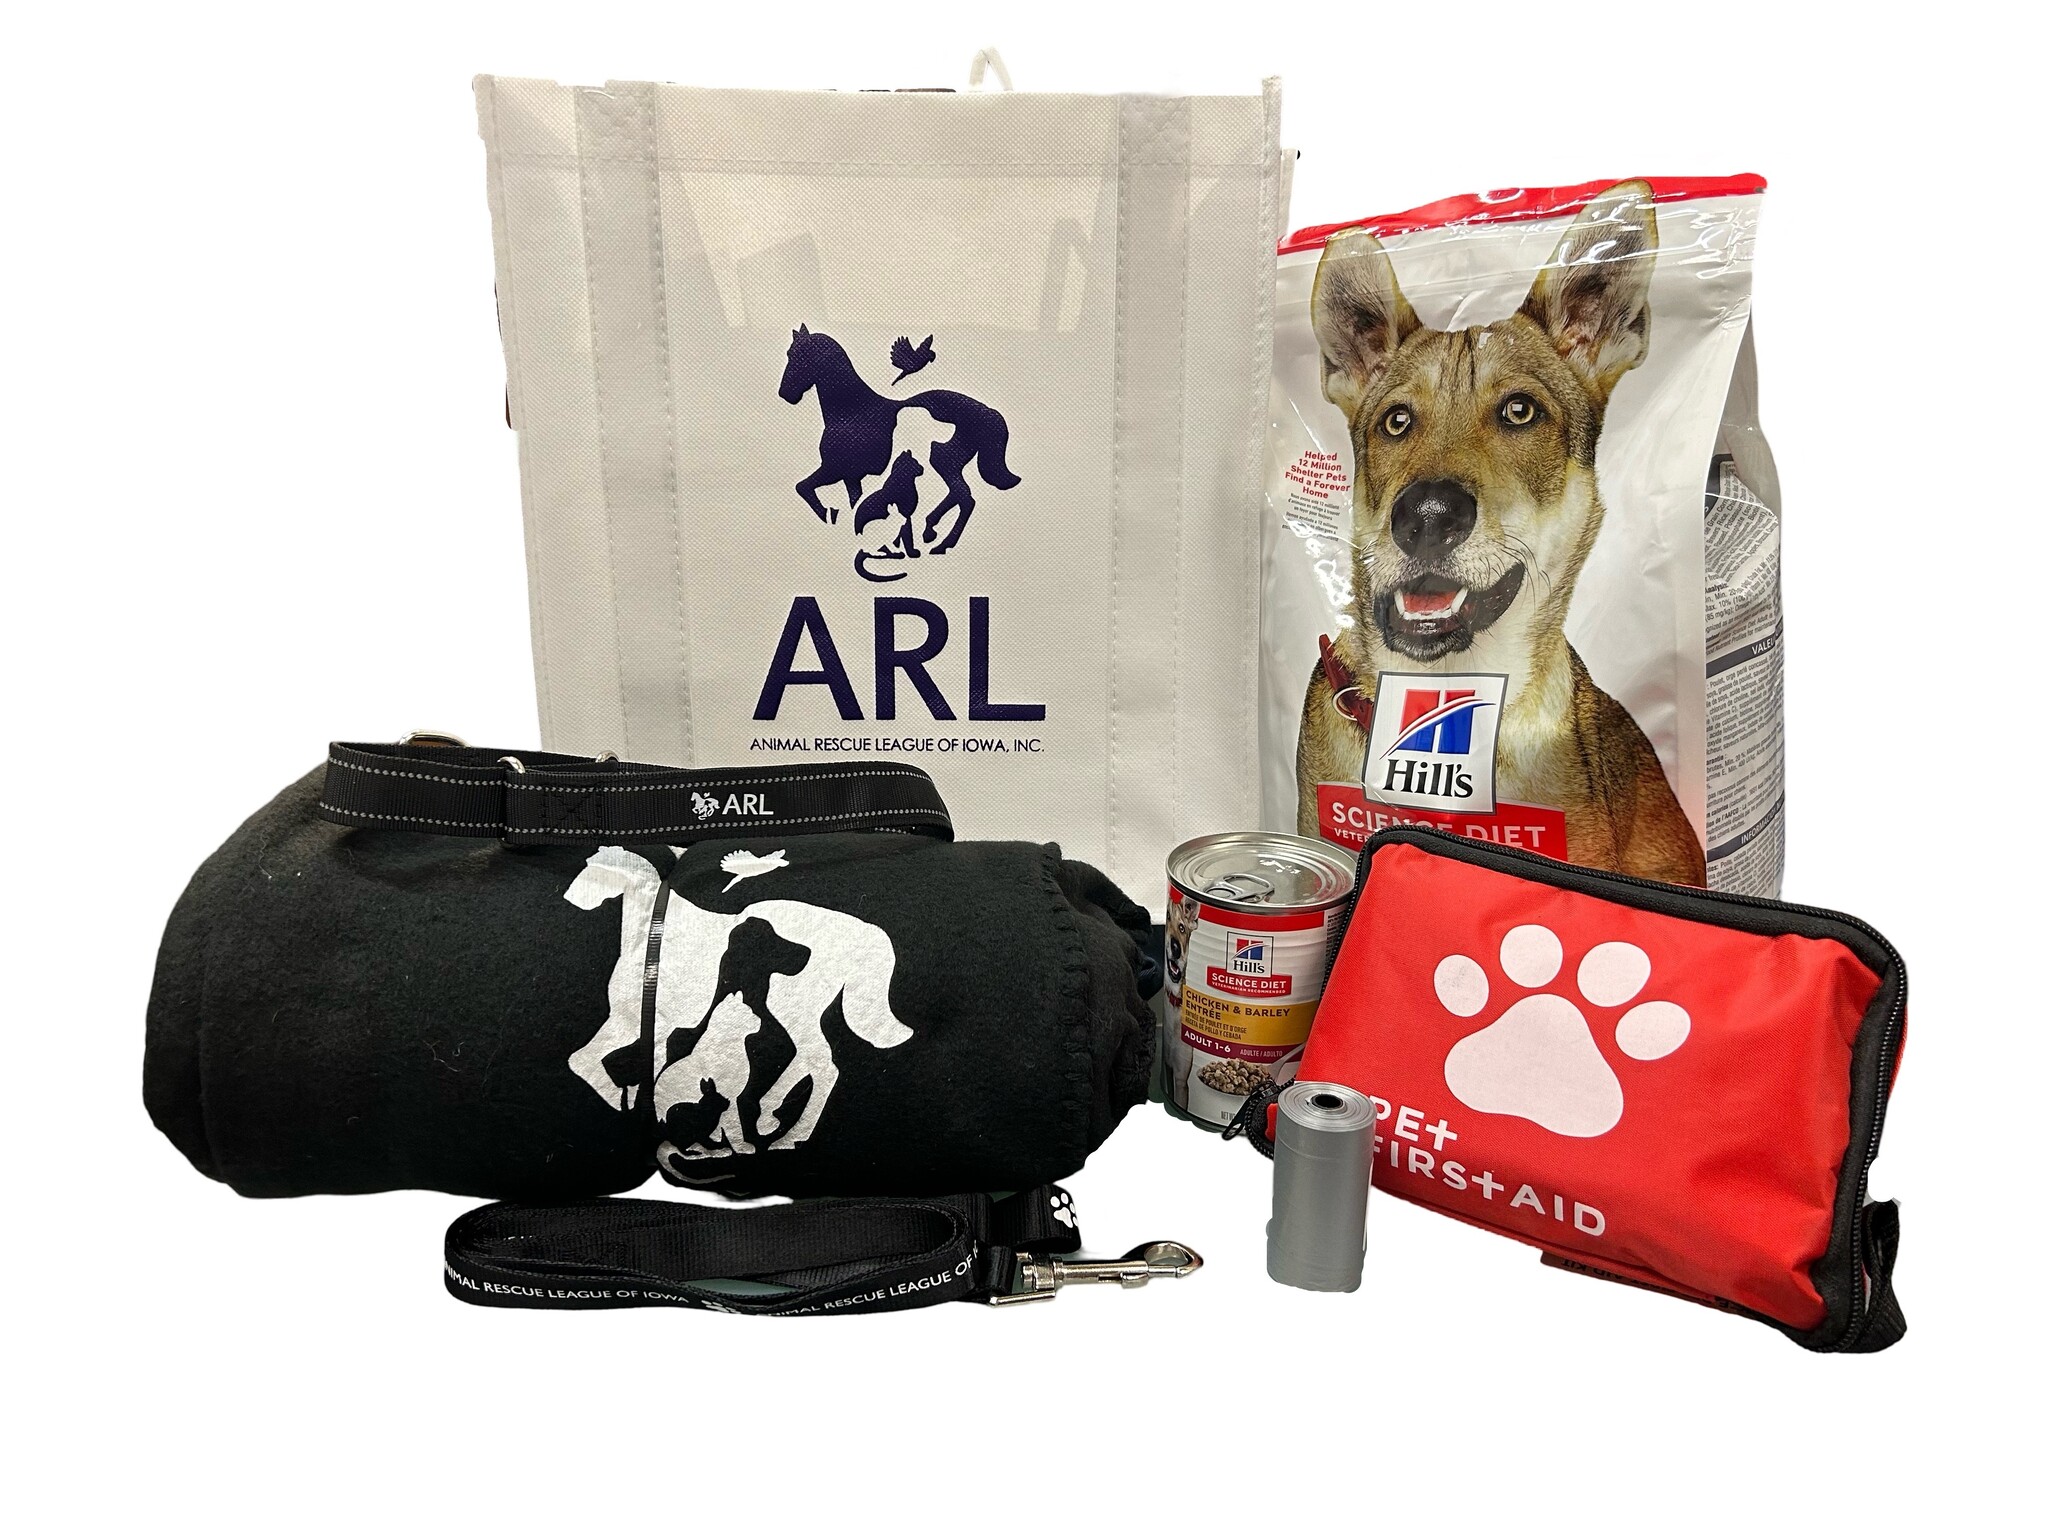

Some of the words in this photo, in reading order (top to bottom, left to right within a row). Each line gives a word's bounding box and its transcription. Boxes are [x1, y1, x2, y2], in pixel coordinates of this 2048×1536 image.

[1298, 458, 1309, 467] 12
[1310, 461, 1342, 472] Million
[1304, 450, 1338, 461] Helped
[1285, 471, 1304, 484] Find
[1314, 480, 1351, 492] Forever
[1290, 464, 1324, 479] Shelter
[1326, 472, 1347, 482] Pets
[1302, 486, 1329, 499] Home
[752, 596, 1046, 721] ARL
[750, 738, 811, 751] ANIMAL
[814, 738, 872, 751] RESCUE
[875, 738, 934, 752] LEAGUE
[937, 739, 959, 752] OF
[962, 739, 1010, 753] IOWA,
[1013, 739, 1045, 752] INC.
[1382, 758, 1474, 799] Hill's
[721, 793, 775, 816] ARL
[1465, 824, 1546, 849] DIET
[1233, 960, 1265, 974] Hill's
[1212, 973, 1258, 989] SCIENCE
[1260, 980, 1287, 989] DIET
[1212, 982, 1247, 992] VETERINARIAN
[1185, 990, 1229, 1012] CHICKEN
[1233, 1006, 1241, 1014] &
[1245, 1007, 1291, 1017] BARLEY
[1185, 1000, 1221, 1020] ENTRÉE
[1205, 1019, 1222, 1029] POULET
[1223, 1023, 1229, 1031] ET
[1229, 1024, 1247, 1034] D'ORGE
[1205, 1024, 1219, 1035] POLLO
[1222, 1031, 1242, 1041] CEBADA
[1184, 1030, 1213, 1048] ADULT
[1214, 1042, 1231, 1053] 1-6
[1239, 1049, 1260, 1057] ADULTE
[1263, 1050, 1283, 1058] ADULTO
[1510, 1184, 1606, 1237] AID
[824, 1288, 886, 1309] RESCUE
[889, 1270, 952, 1297] LEAGUE
[954, 1254, 974, 1277] OF
[483, 1282, 545, 1298] RESCUE
[548, 1289, 613, 1299] LEAGUE
[616, 1289, 638, 1299] OF
[643, 1291, 690, 1303] IOWA
